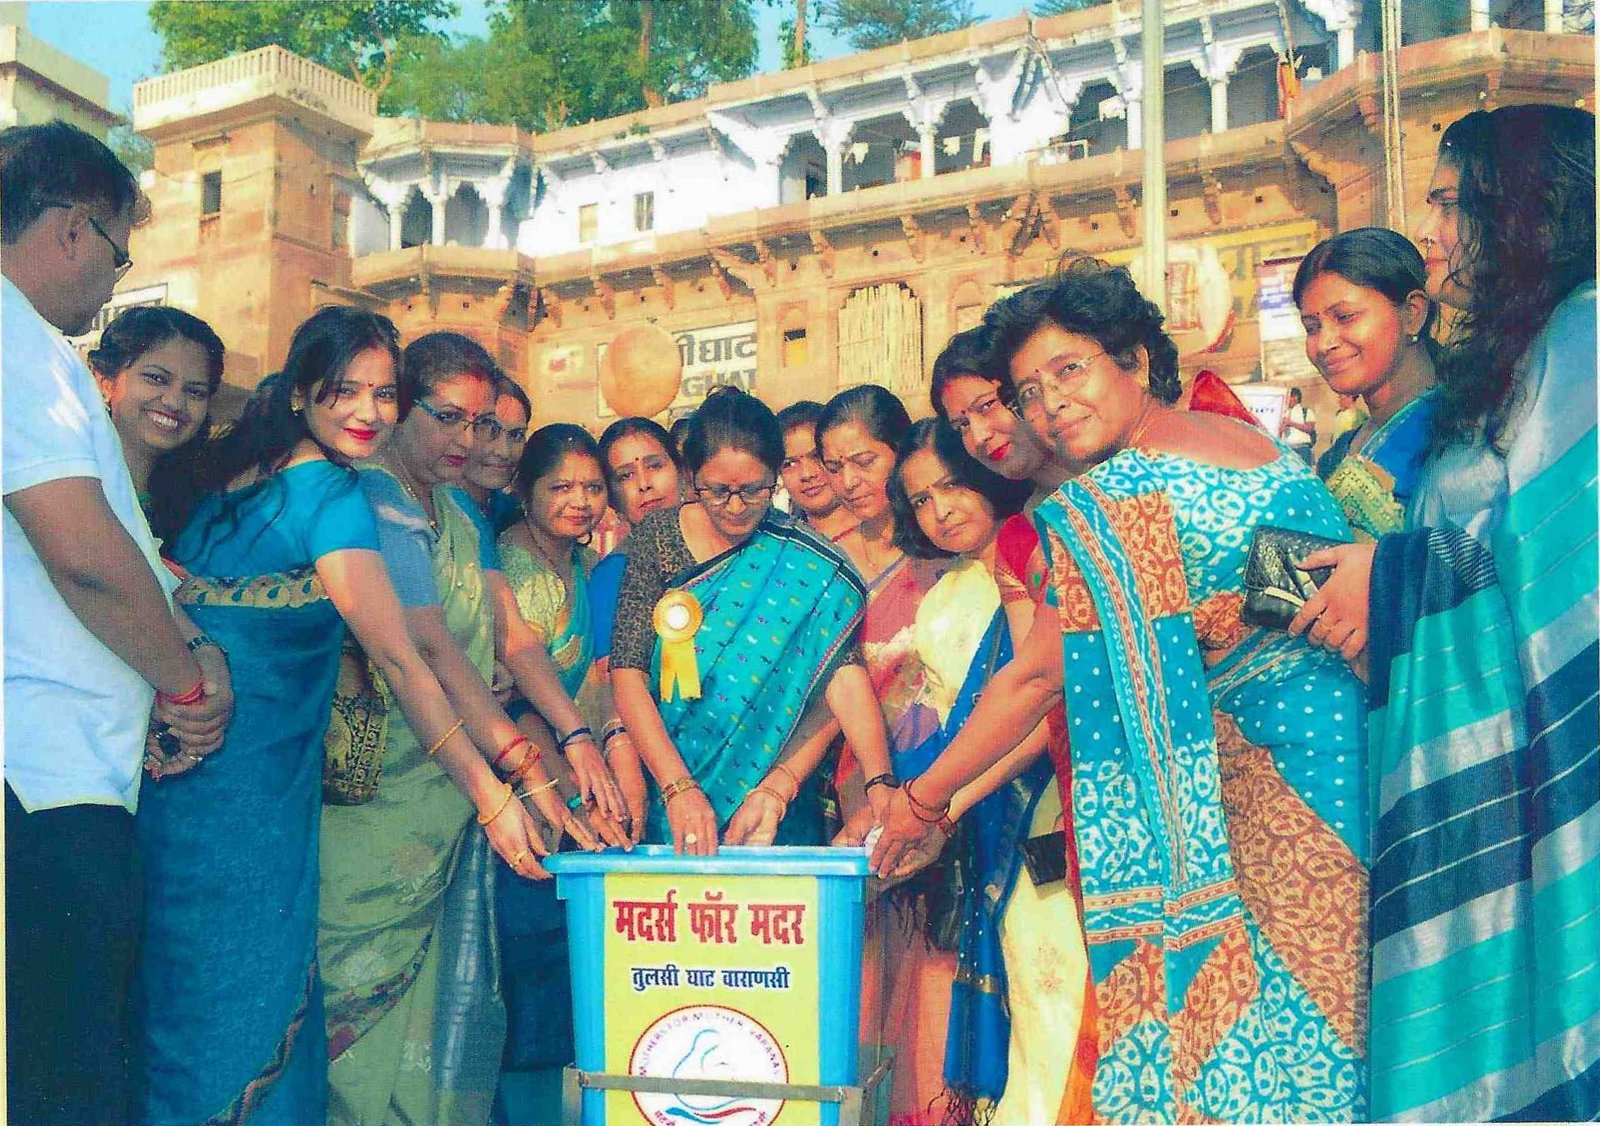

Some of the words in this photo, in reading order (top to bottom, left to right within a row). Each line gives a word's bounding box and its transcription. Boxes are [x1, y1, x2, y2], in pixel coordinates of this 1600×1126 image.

[613, 889, 677, 941] मदर्स
[688, 891, 738, 943] फॉर
[748, 904, 805, 944] मदर
[632, 964, 679, 991] तुलसी
[686, 969, 715, 987] घाट
[721, 966, 790, 988] वाराणसी
